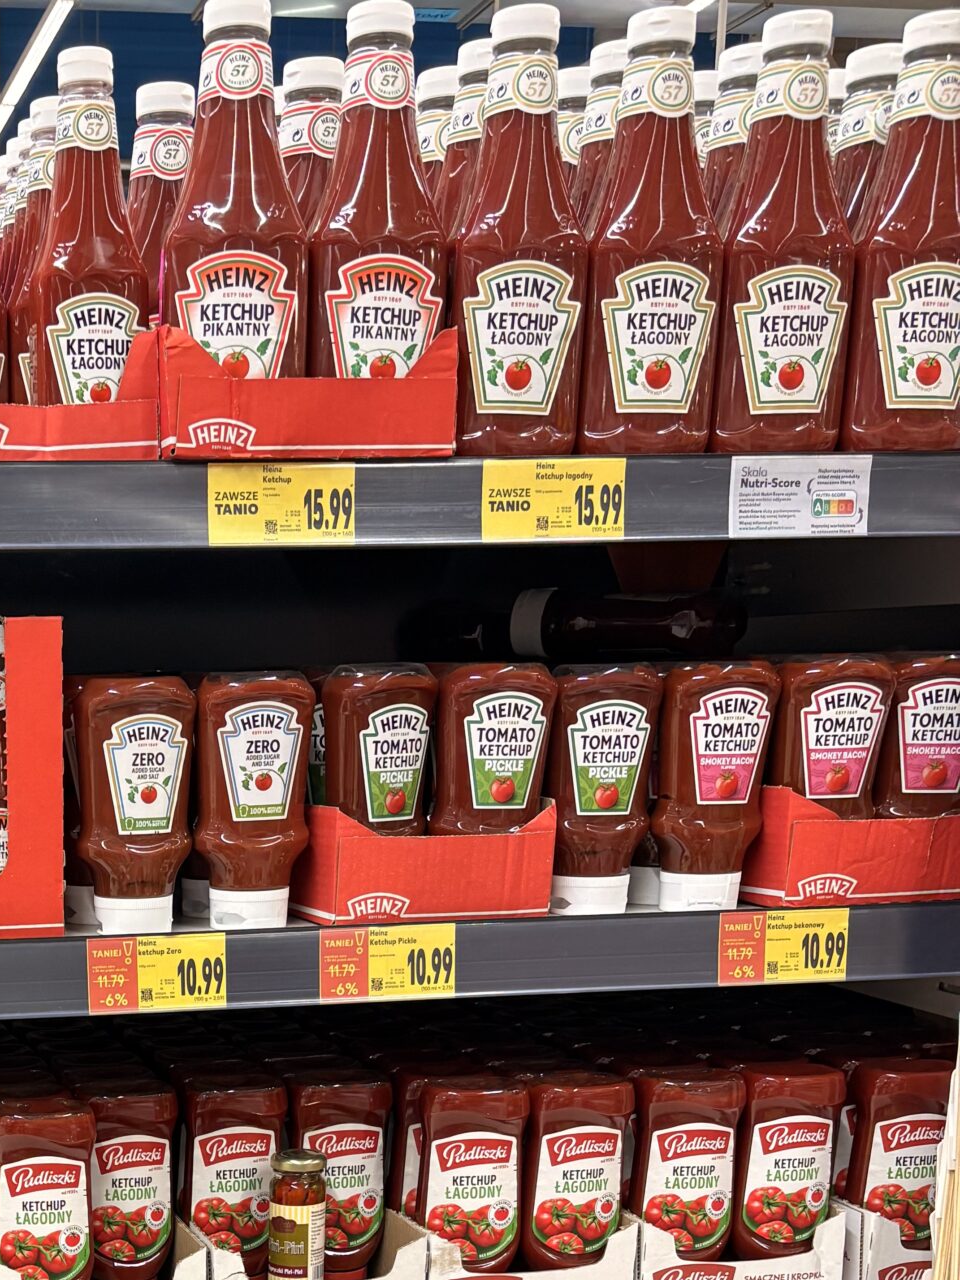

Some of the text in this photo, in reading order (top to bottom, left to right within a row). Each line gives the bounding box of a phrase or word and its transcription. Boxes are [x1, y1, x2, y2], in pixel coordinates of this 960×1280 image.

[230, 54, 251, 64] HEINZ
[231, 65, 248, 77] 57
[205, 267, 269, 294] HEINZ
[495, 278, 555, 303] HEINZ
[200, 303, 274, 321] KETCHUP
[203, 323, 269, 337] PIKANTNY
[486, 313, 558, 332] KETCHUP
[491, 332, 551, 347] ŁAGODNY
[196, 424, 249, 446] HEINZ
[262, 475, 292, 484] Ketchup
[536, 471, 593, 481] Ketchup łagodny
[742, 467, 767, 477] Skala
[740, 478, 801, 488] Nutri-Score
[304, 488, 353, 529] 15.99
[575, 484, 622, 526] 15.99
[589, 710, 636, 729] HEINZ
[127, 727, 169, 743] HEINZ
[703, 723, 759, 739] TOMATO
[582, 734, 640, 750] TOMATO
[704, 738, 756, 753] KETCHUP
[132, 752, 165, 766] ZERO
[583, 749, 636, 764] KETCHUP
[700, 756, 754, 766] SMOKEY BACON
[589, 767, 628, 779] PICKLE
[767, 921, 825, 930] Ketchup bekonowy
[369, 936, 417, 946] Ketchup Pickle
[92, 949, 122, 959] TANIEJ
[138, 947, 182, 956] ketchup Zero
[802, 932, 845, 969] 10.99
[408, 947, 452, 985] 10.99
[97, 975, 125, 987] 11.79
[178, 956, 223, 996] 10.99
[99, 993, 128, 1006] -6%
[11, 1165, 77, 1191] Pudliszki
[22, 1200, 66, 1214] KETCHUP
[15, 1210, 73, 1226] ŁAGODNY
